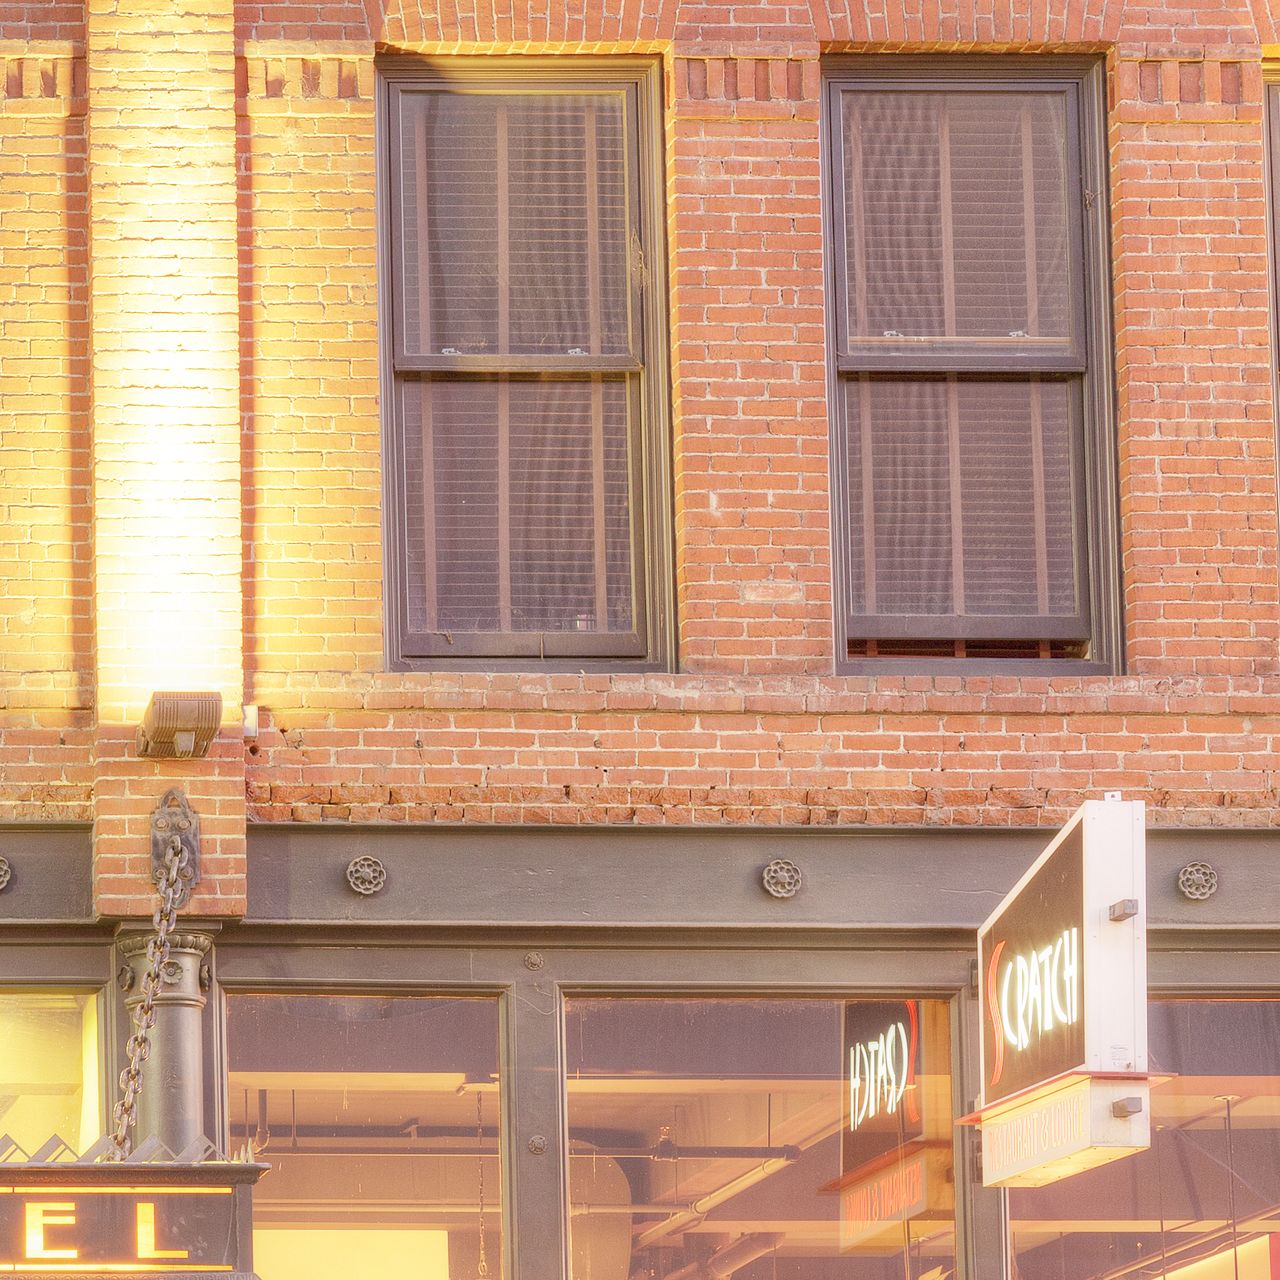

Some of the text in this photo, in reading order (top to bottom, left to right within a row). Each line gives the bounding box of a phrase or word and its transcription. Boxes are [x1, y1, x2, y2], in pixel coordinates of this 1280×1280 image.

[988, 927, 1078, 1088] SCRATCH
[989, 1109, 1040, 1172] RESTAURANT
[1051, 1094, 1086, 1149] LOUNGE
